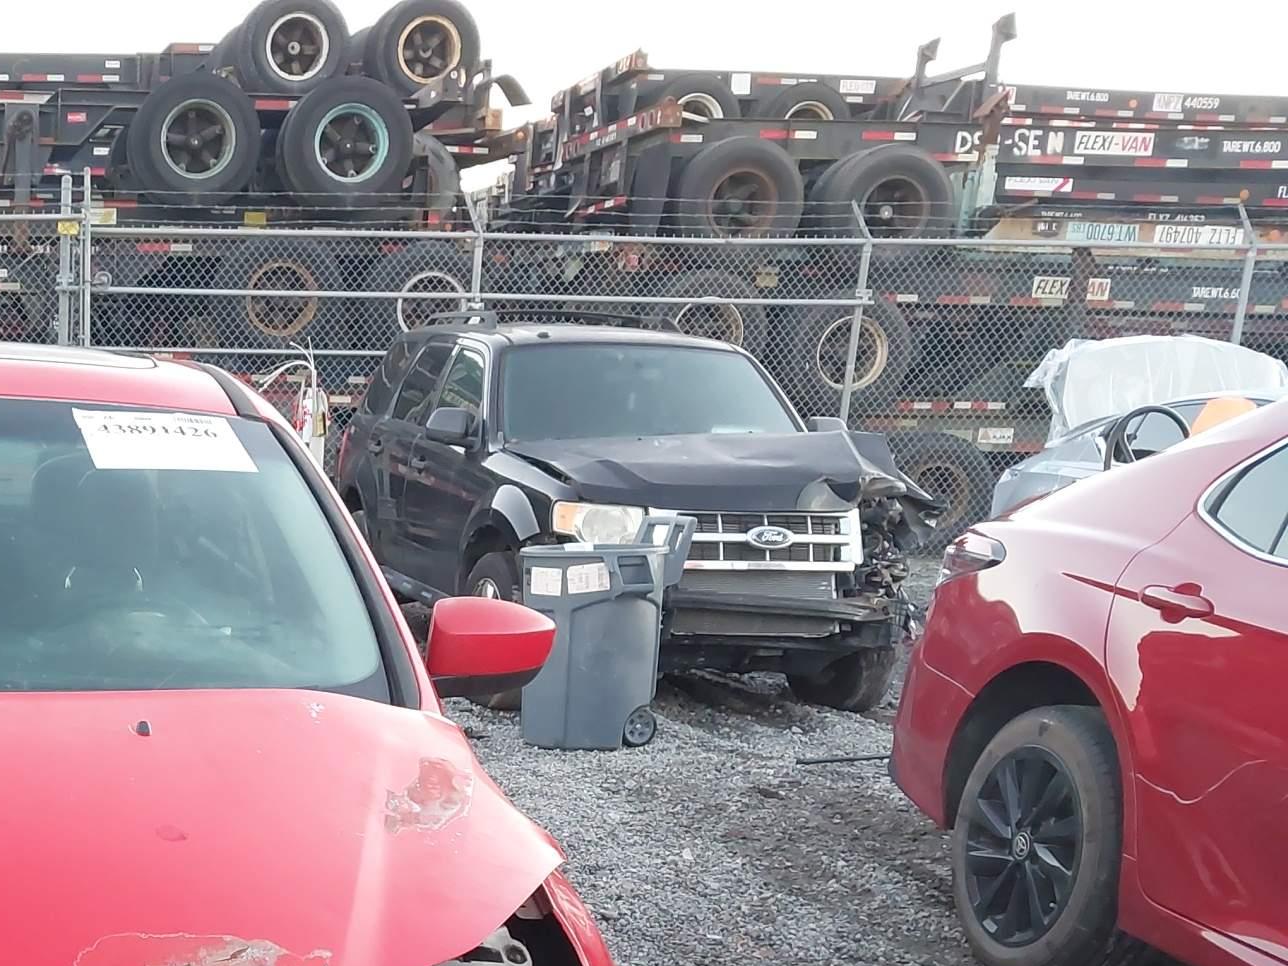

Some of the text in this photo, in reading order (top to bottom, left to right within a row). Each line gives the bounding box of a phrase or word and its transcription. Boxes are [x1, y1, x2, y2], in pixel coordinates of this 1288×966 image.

[1076, 134, 1151, 152] FLEXI-VAN
[1159, 226, 1202, 245] 407497
[97, 422, 218, 438] 43891426
[762, 530, 784, 543] Ford
